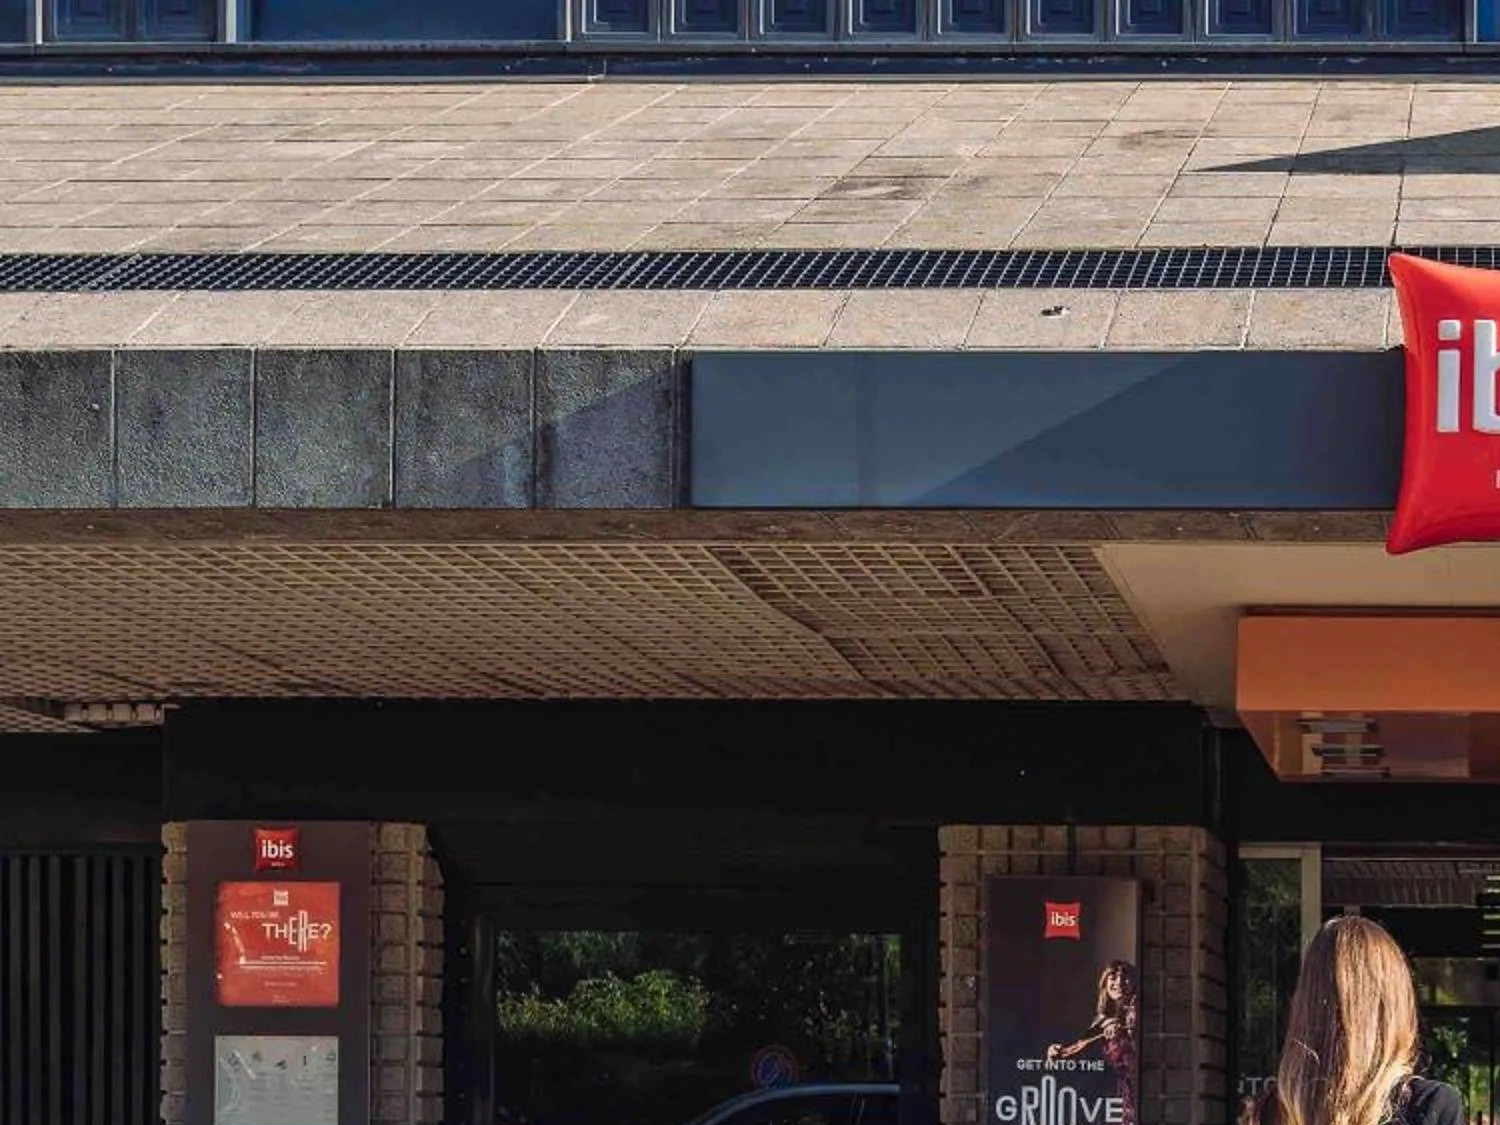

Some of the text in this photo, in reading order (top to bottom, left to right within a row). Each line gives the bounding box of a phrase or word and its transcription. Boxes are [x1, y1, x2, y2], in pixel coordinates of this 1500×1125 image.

[262, 839, 294, 859] ibis
[1051, 911, 1077, 927] ibis
[261, 910, 332, 952] THERE?
[1016, 1058, 1105, 1071] GET INTO THE
